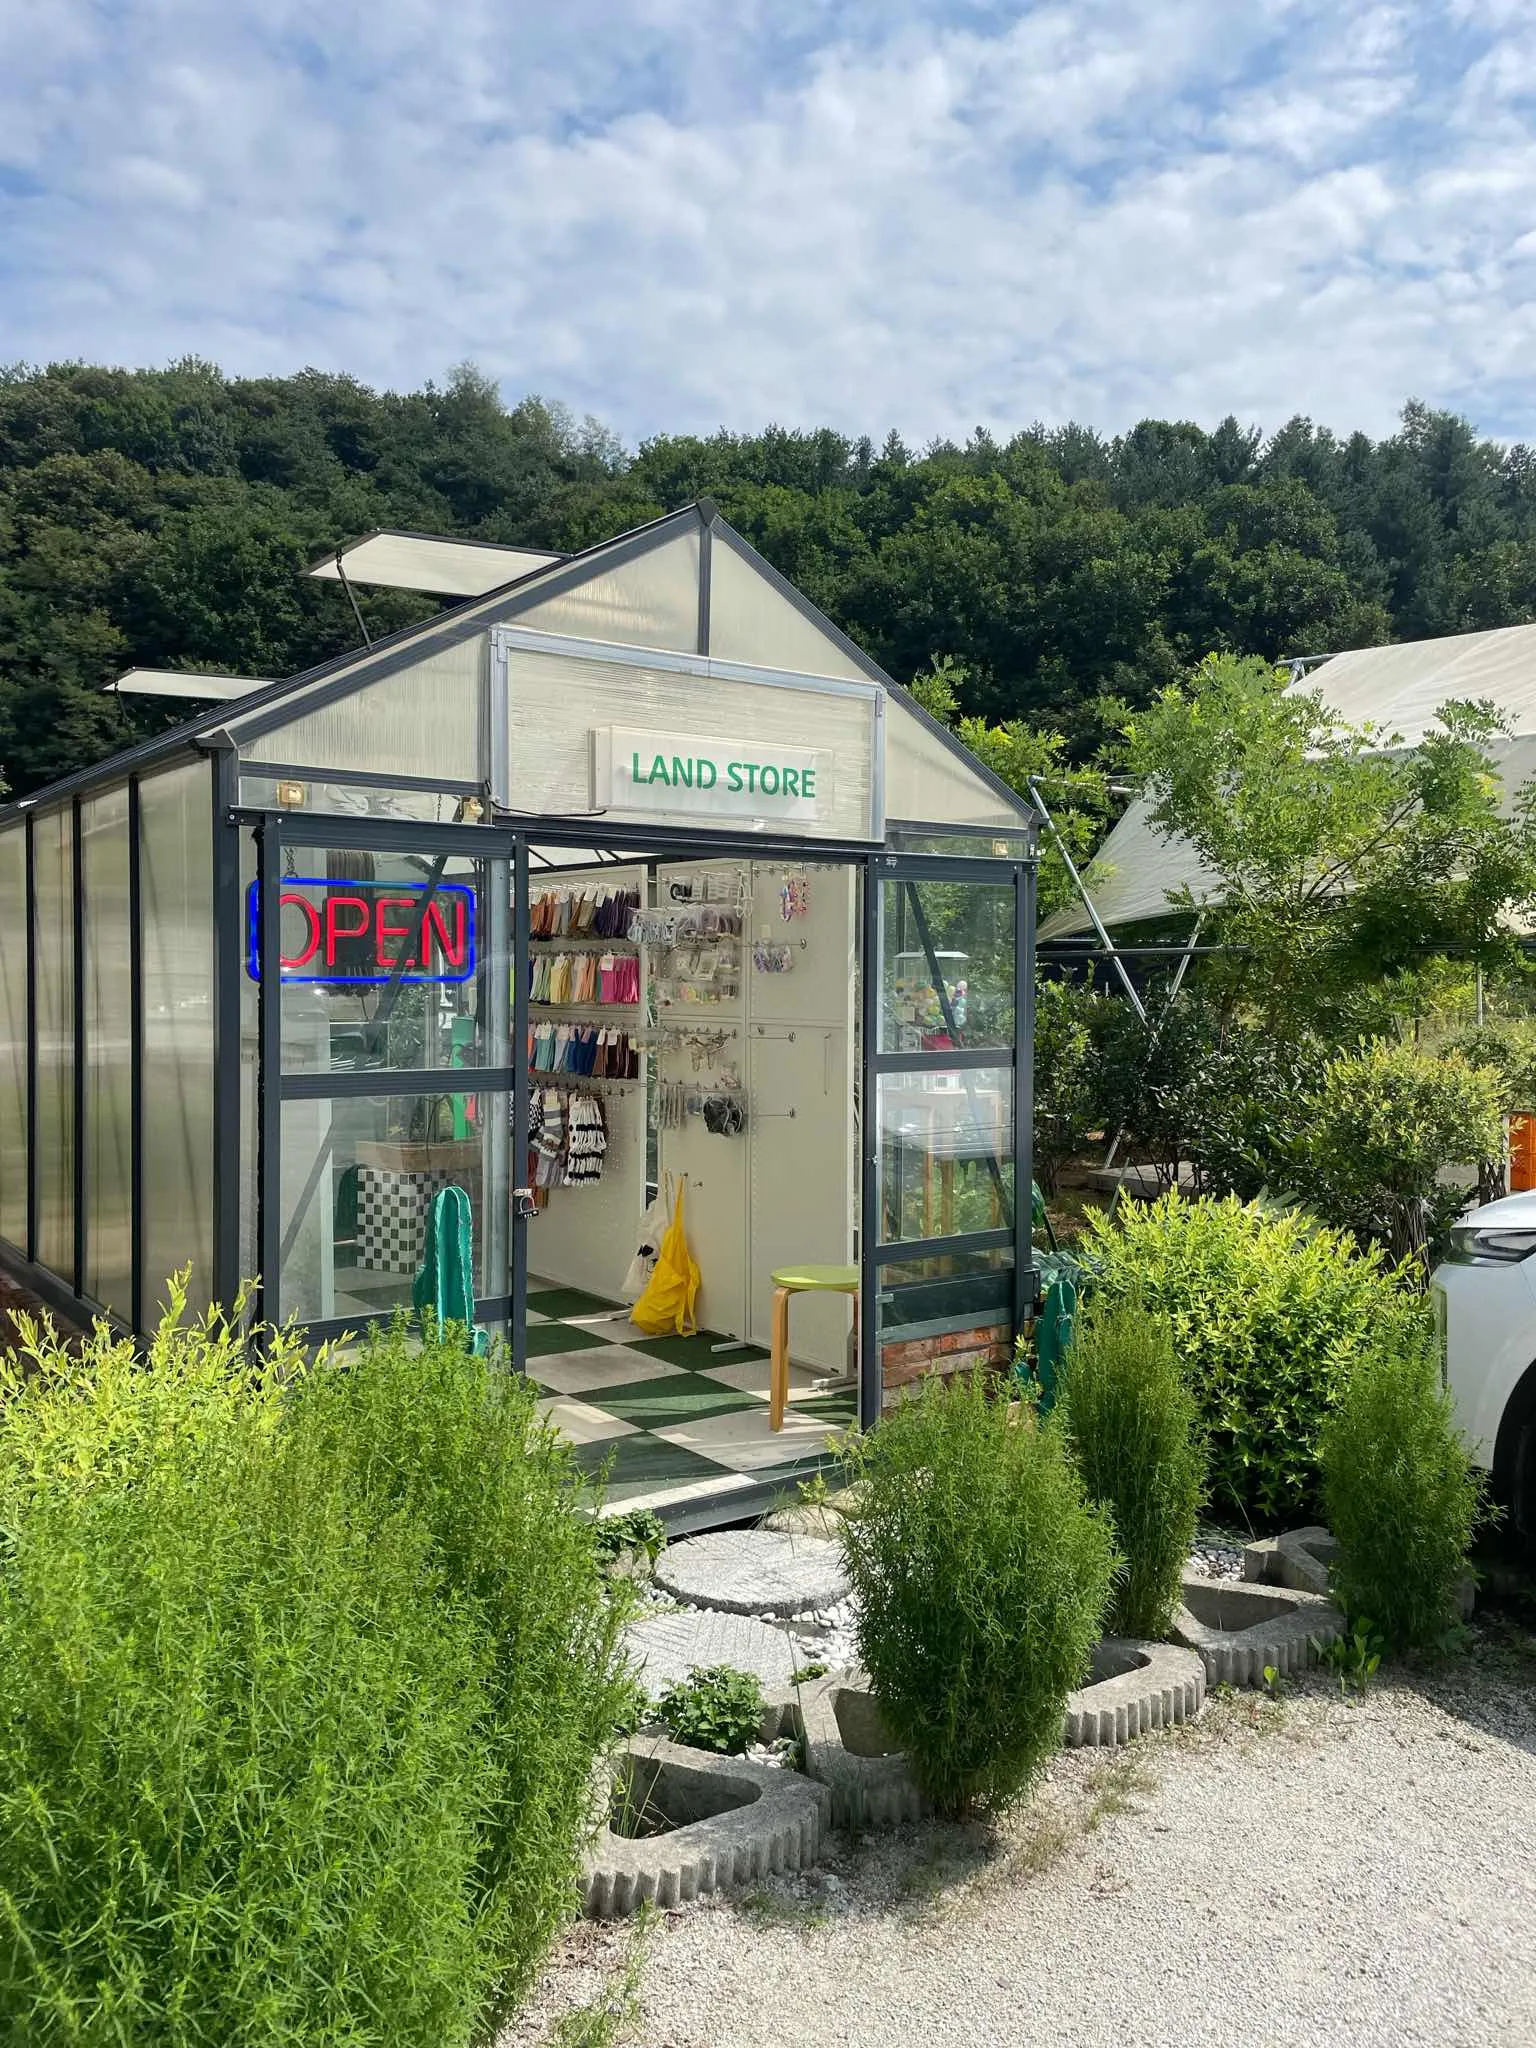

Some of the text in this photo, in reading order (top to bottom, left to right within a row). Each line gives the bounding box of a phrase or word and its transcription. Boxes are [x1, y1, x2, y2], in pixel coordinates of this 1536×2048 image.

[632, 752, 816, 798] LAND STORE
[279, 893, 464, 968] OPEN
